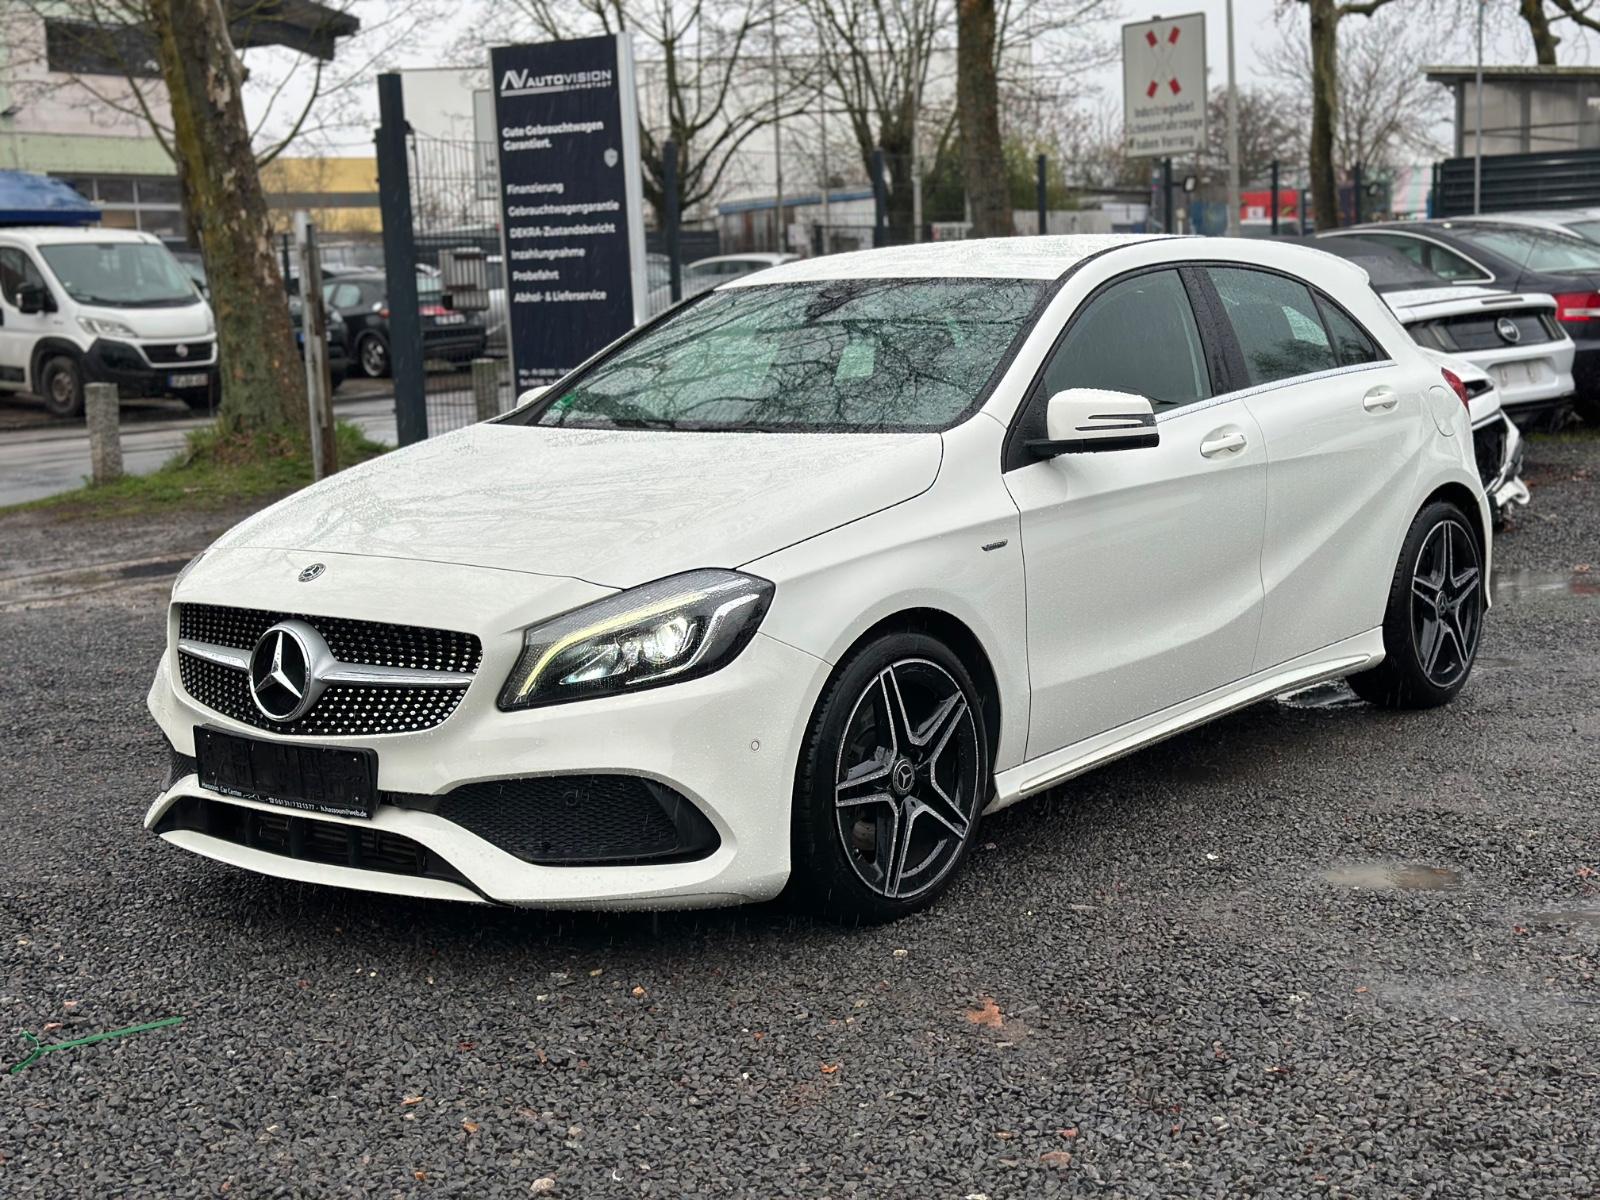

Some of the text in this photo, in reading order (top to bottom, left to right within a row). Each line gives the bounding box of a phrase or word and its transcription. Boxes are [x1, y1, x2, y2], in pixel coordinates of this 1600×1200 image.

[526, 70, 611, 87] AUTOVISION
[502, 121, 603, 138] Gute Gebrauchtwagen
[503, 138, 552, 151] Garantiert.
[506, 182, 564, 195] Finanzierung
[508, 201, 619, 216] Gebrauchtwagengarantie
[512, 270, 560, 281] Probefahrt
[514, 289, 607, 302] Abhol- & Lieferservice
